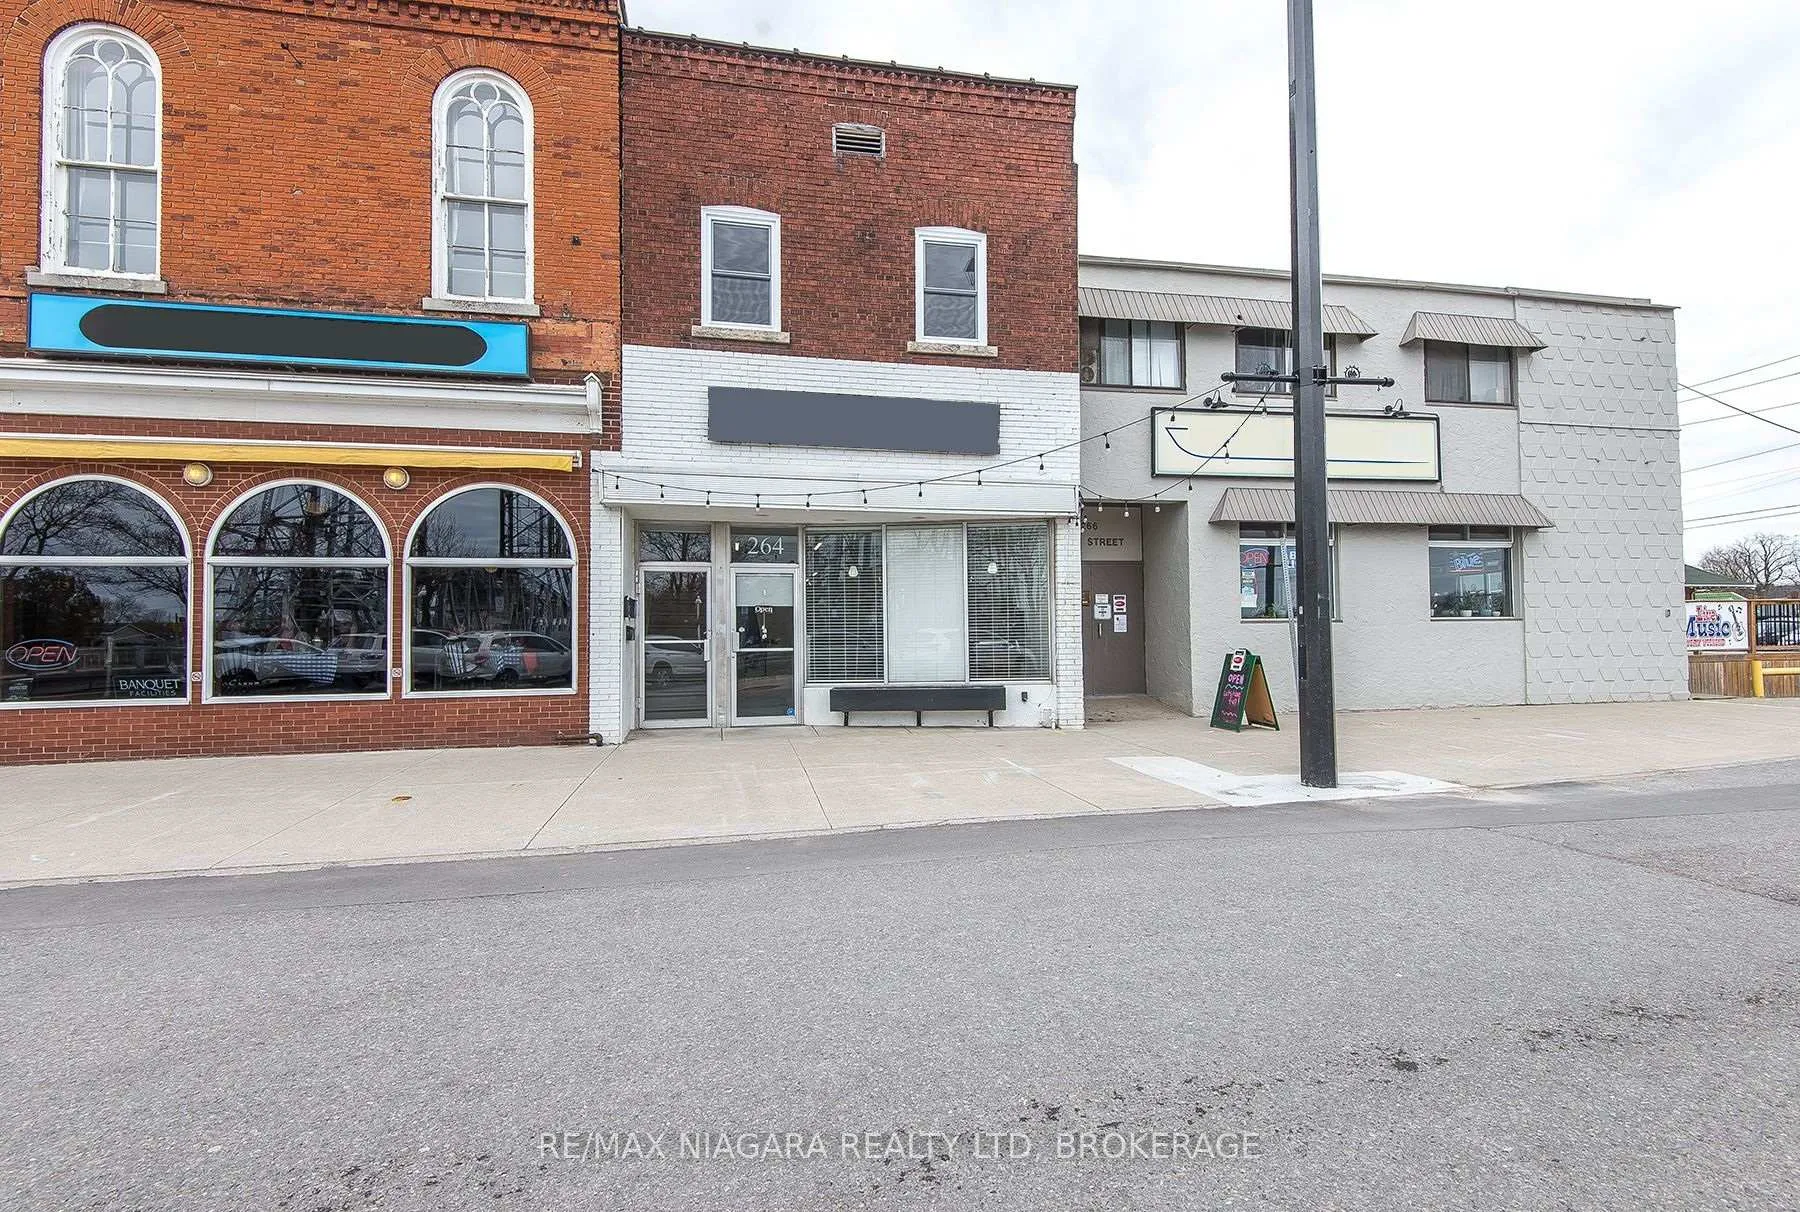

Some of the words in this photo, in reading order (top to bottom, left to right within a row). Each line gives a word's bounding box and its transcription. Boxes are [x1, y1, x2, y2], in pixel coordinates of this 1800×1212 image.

[747, 536, 784, 555] 264
[1087, 537, 1125, 547] STREET
[754, 605, 773, 614] Open
[8, 646, 78, 663] OPEN
[1228, 673, 1244, 685] OPEN
[119, 679, 179, 692] BANQUET
